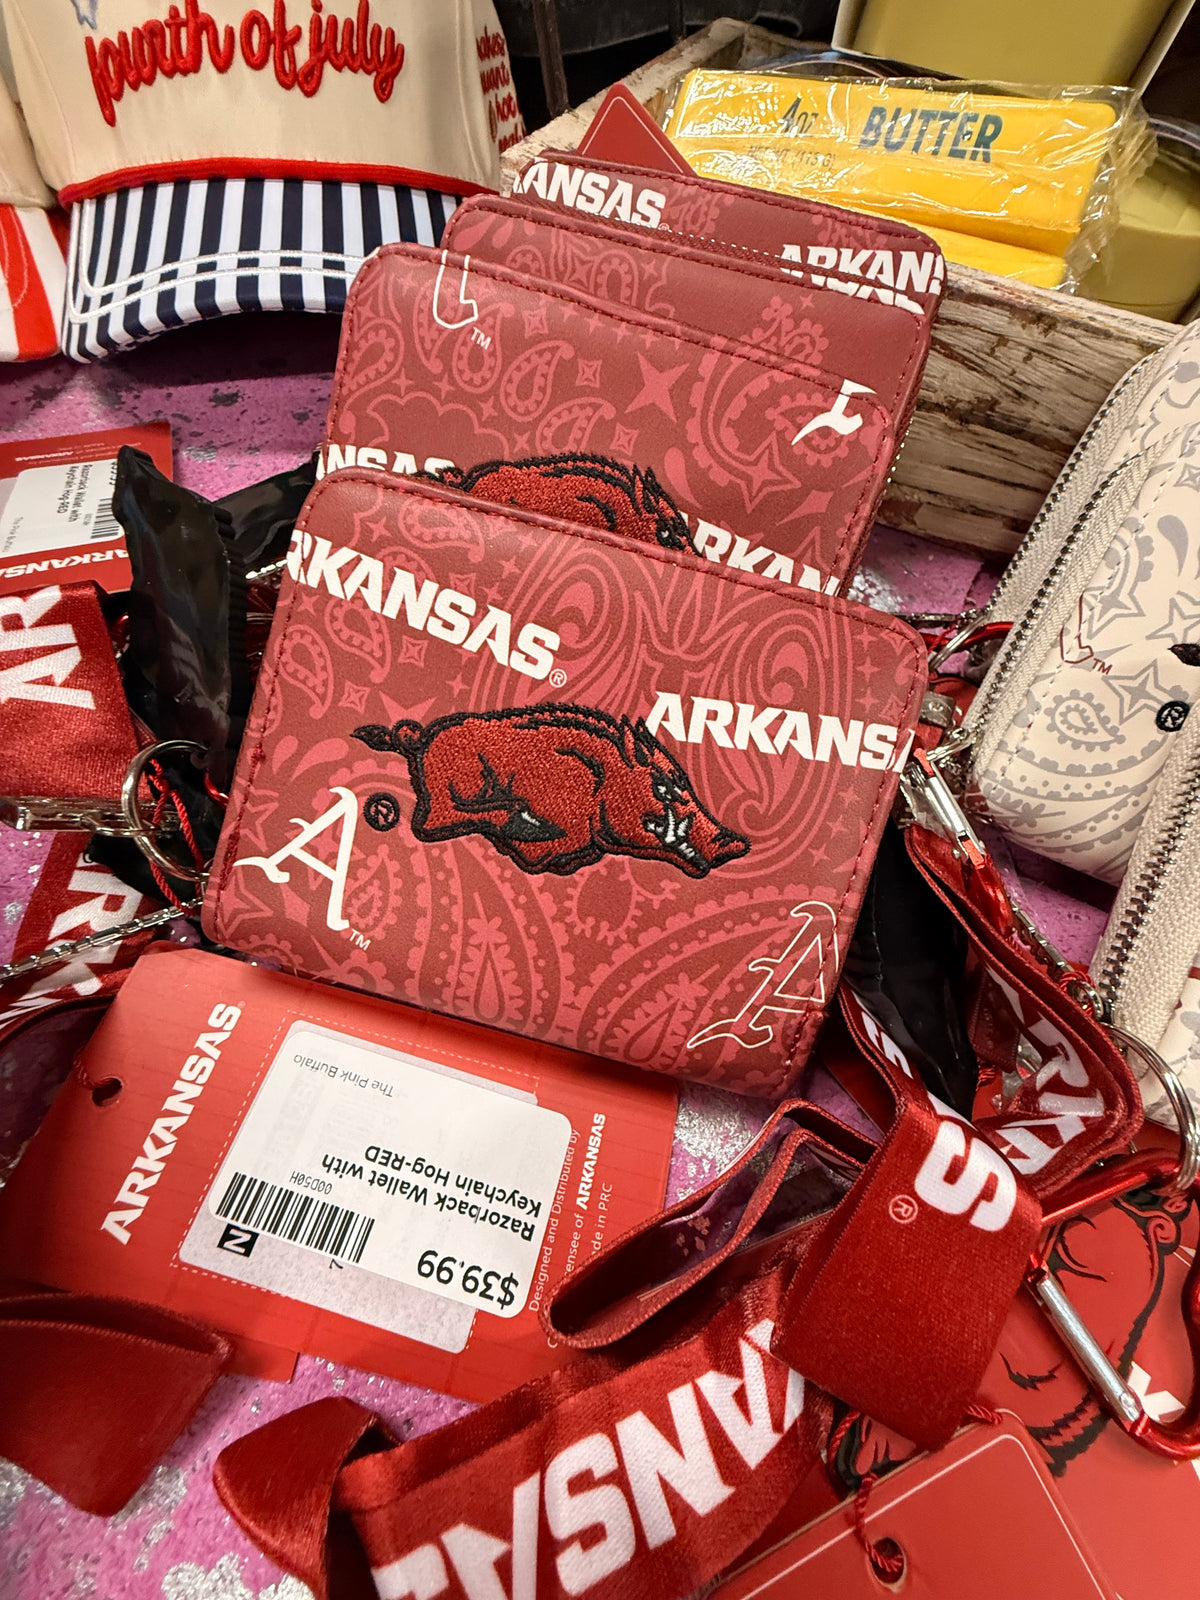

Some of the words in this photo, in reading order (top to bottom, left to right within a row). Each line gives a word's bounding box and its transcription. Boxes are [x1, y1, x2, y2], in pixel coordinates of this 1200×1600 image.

[241, 0, 302, 90] of
[297, 0, 405, 103] july
[858, 106, 1004, 163] BUTTER
[0, 549, 129, 579] ARKANS
[1092, 657, 1113, 675] TM
[350, 928, 371, 951] TM
[293, 1054, 339, 1079] Buffalo
[340, 1069, 370, 1089] Pink
[372, 1079, 394, 1098] The
[99, 1003, 242, 1245] ARKANSAS
[569, 1128, 581, 1144] by
[321, 1154, 365, 1180] with
[364, 1145, 450, 1187] Hog-RED
[576, 1112, 606, 1211] ARKANSAS
[368, 1170, 429, 1206] Wallet
[455, 1173, 542, 1218] Keychain
[551, 1144, 576, 1214] Distributed
[599, 1181, 613, 1212] PRC
[434, 1192, 536, 1242] Razorback
[547, 1217, 560, 1244] and
[574, 1213, 585, 1230] of
[597, 1215, 606, 1229] in
[564, 1229, 582, 1277] ensee
[417, 1249, 519, 1310] $39.99
[529, 1246, 553, 1312] Designed
